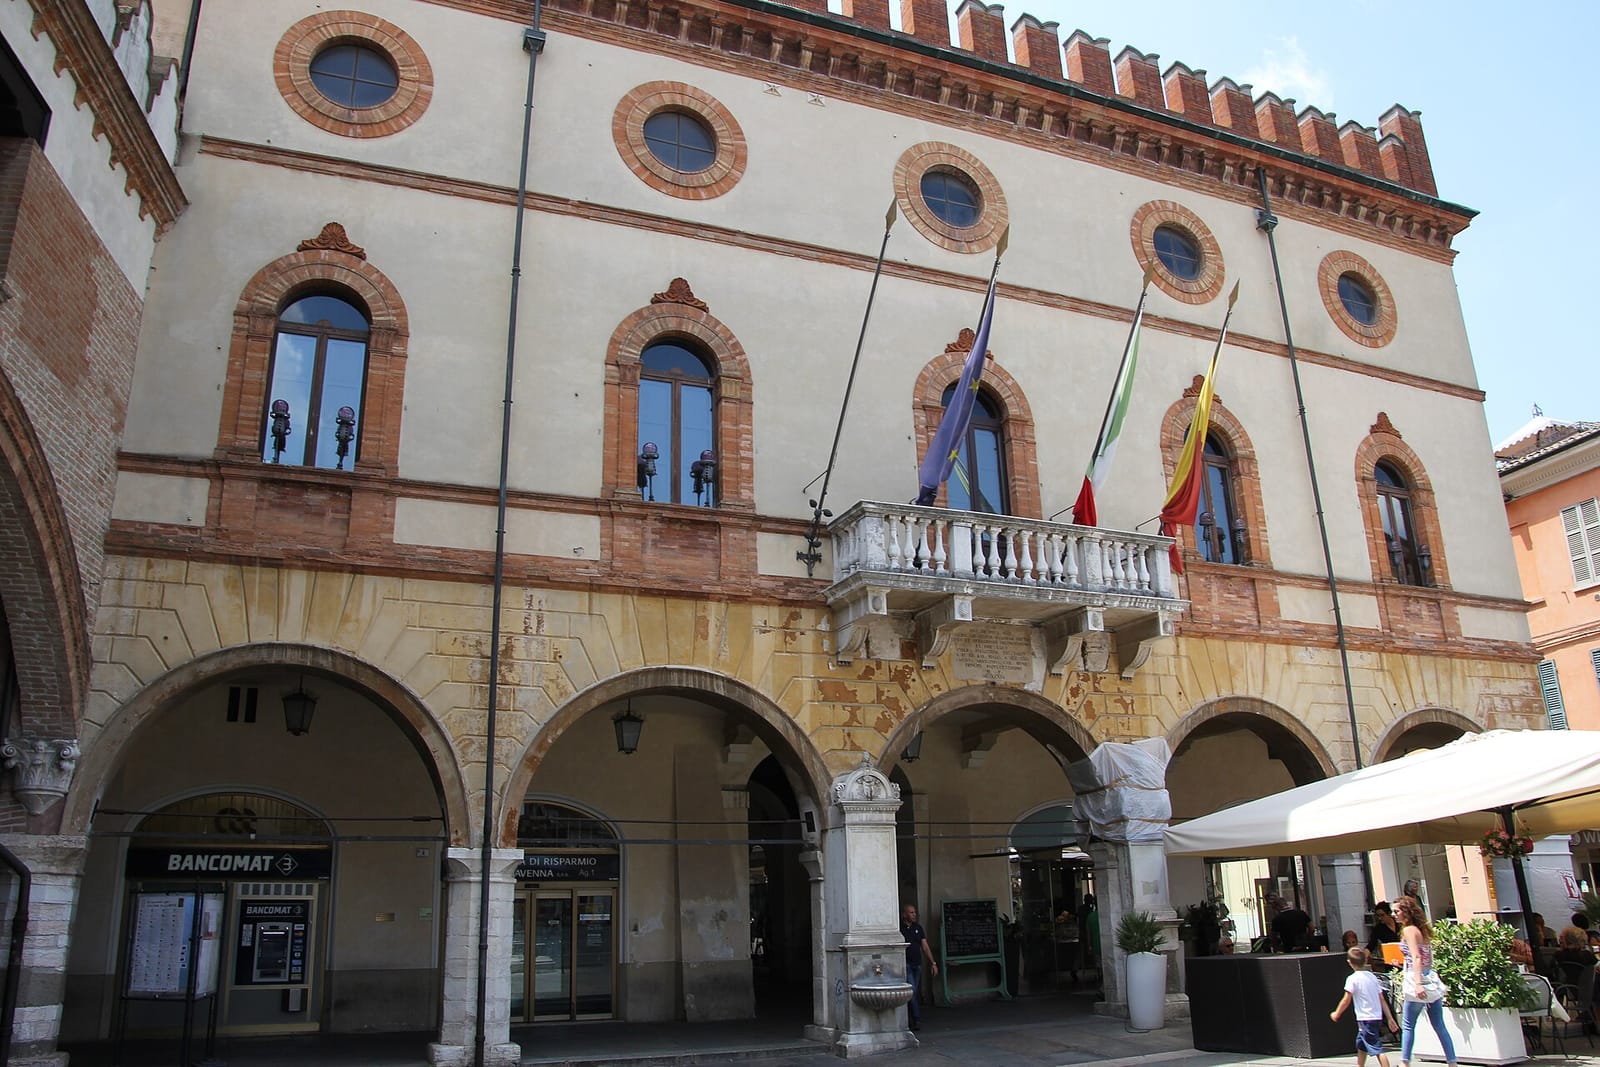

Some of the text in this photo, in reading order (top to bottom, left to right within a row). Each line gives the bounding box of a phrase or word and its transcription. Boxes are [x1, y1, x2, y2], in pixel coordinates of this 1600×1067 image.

[167, 854, 274, 872] BANCOMAT
[529, 857, 540, 866] DI
[543, 857, 597, 866] RISPARMIO
[516, 869, 554, 878] AVENNA
[246, 905, 292, 915] BANCOMAT
